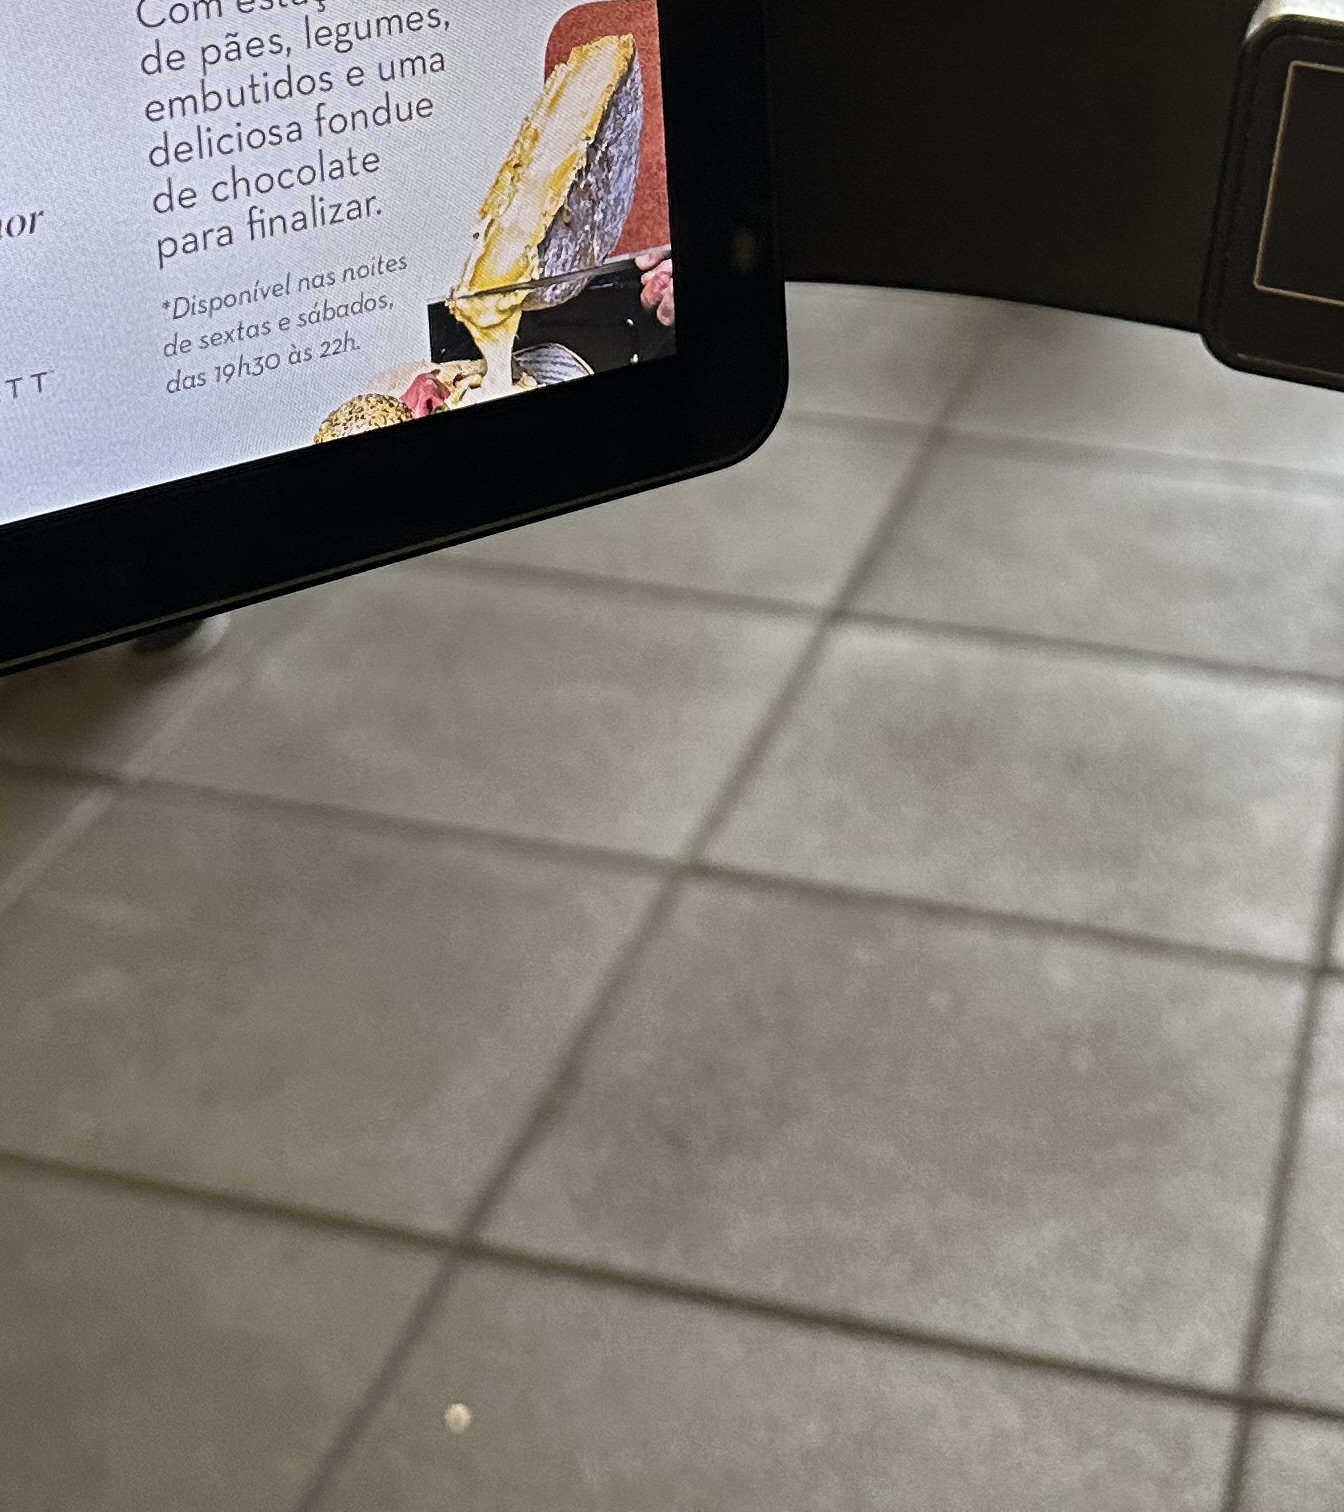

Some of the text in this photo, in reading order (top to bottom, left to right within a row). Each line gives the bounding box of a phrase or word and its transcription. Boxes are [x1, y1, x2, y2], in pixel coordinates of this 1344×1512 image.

[141, 7, 450, 76] de pães, legumes,
[145, 51, 446, 121] embutidos e uma
[149, 91, 434, 167] deliciosa fondue
[153, 147, 381, 214] de chocolate
[158, 193, 382, 270] para finalizar.
[298, 270, 336, 292] nas
[342, 255, 408, 282] noites
[163, 291, 394, 358] de sextas e sábados,
[166, 330, 361, 394] das 19h30 às 22h.
